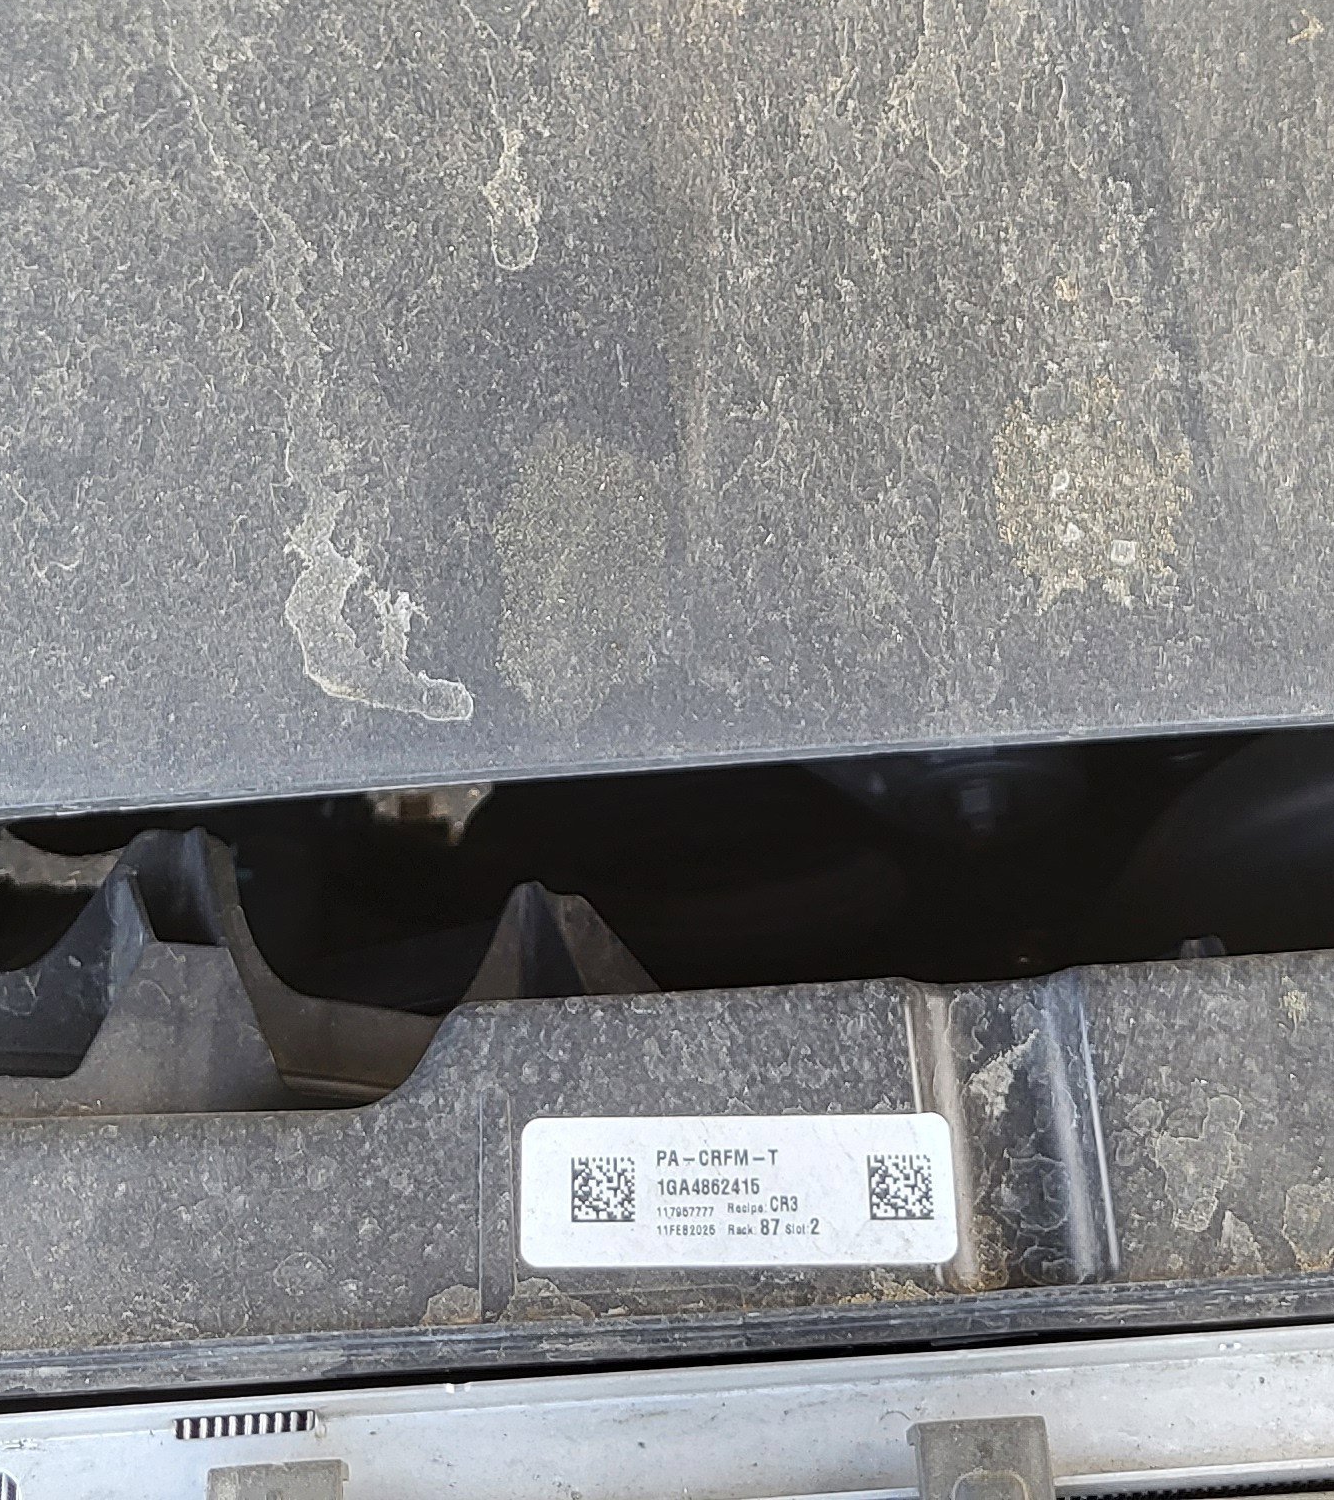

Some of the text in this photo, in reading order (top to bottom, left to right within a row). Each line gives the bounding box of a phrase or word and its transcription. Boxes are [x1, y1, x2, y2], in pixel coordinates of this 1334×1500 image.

[657, 1177, 761, 1196] 1GA4862415
[769, 1195, 799, 1213] CR3
[760, 1218, 781, 1237] 87
[810, 1217, 821, 1236] 2
